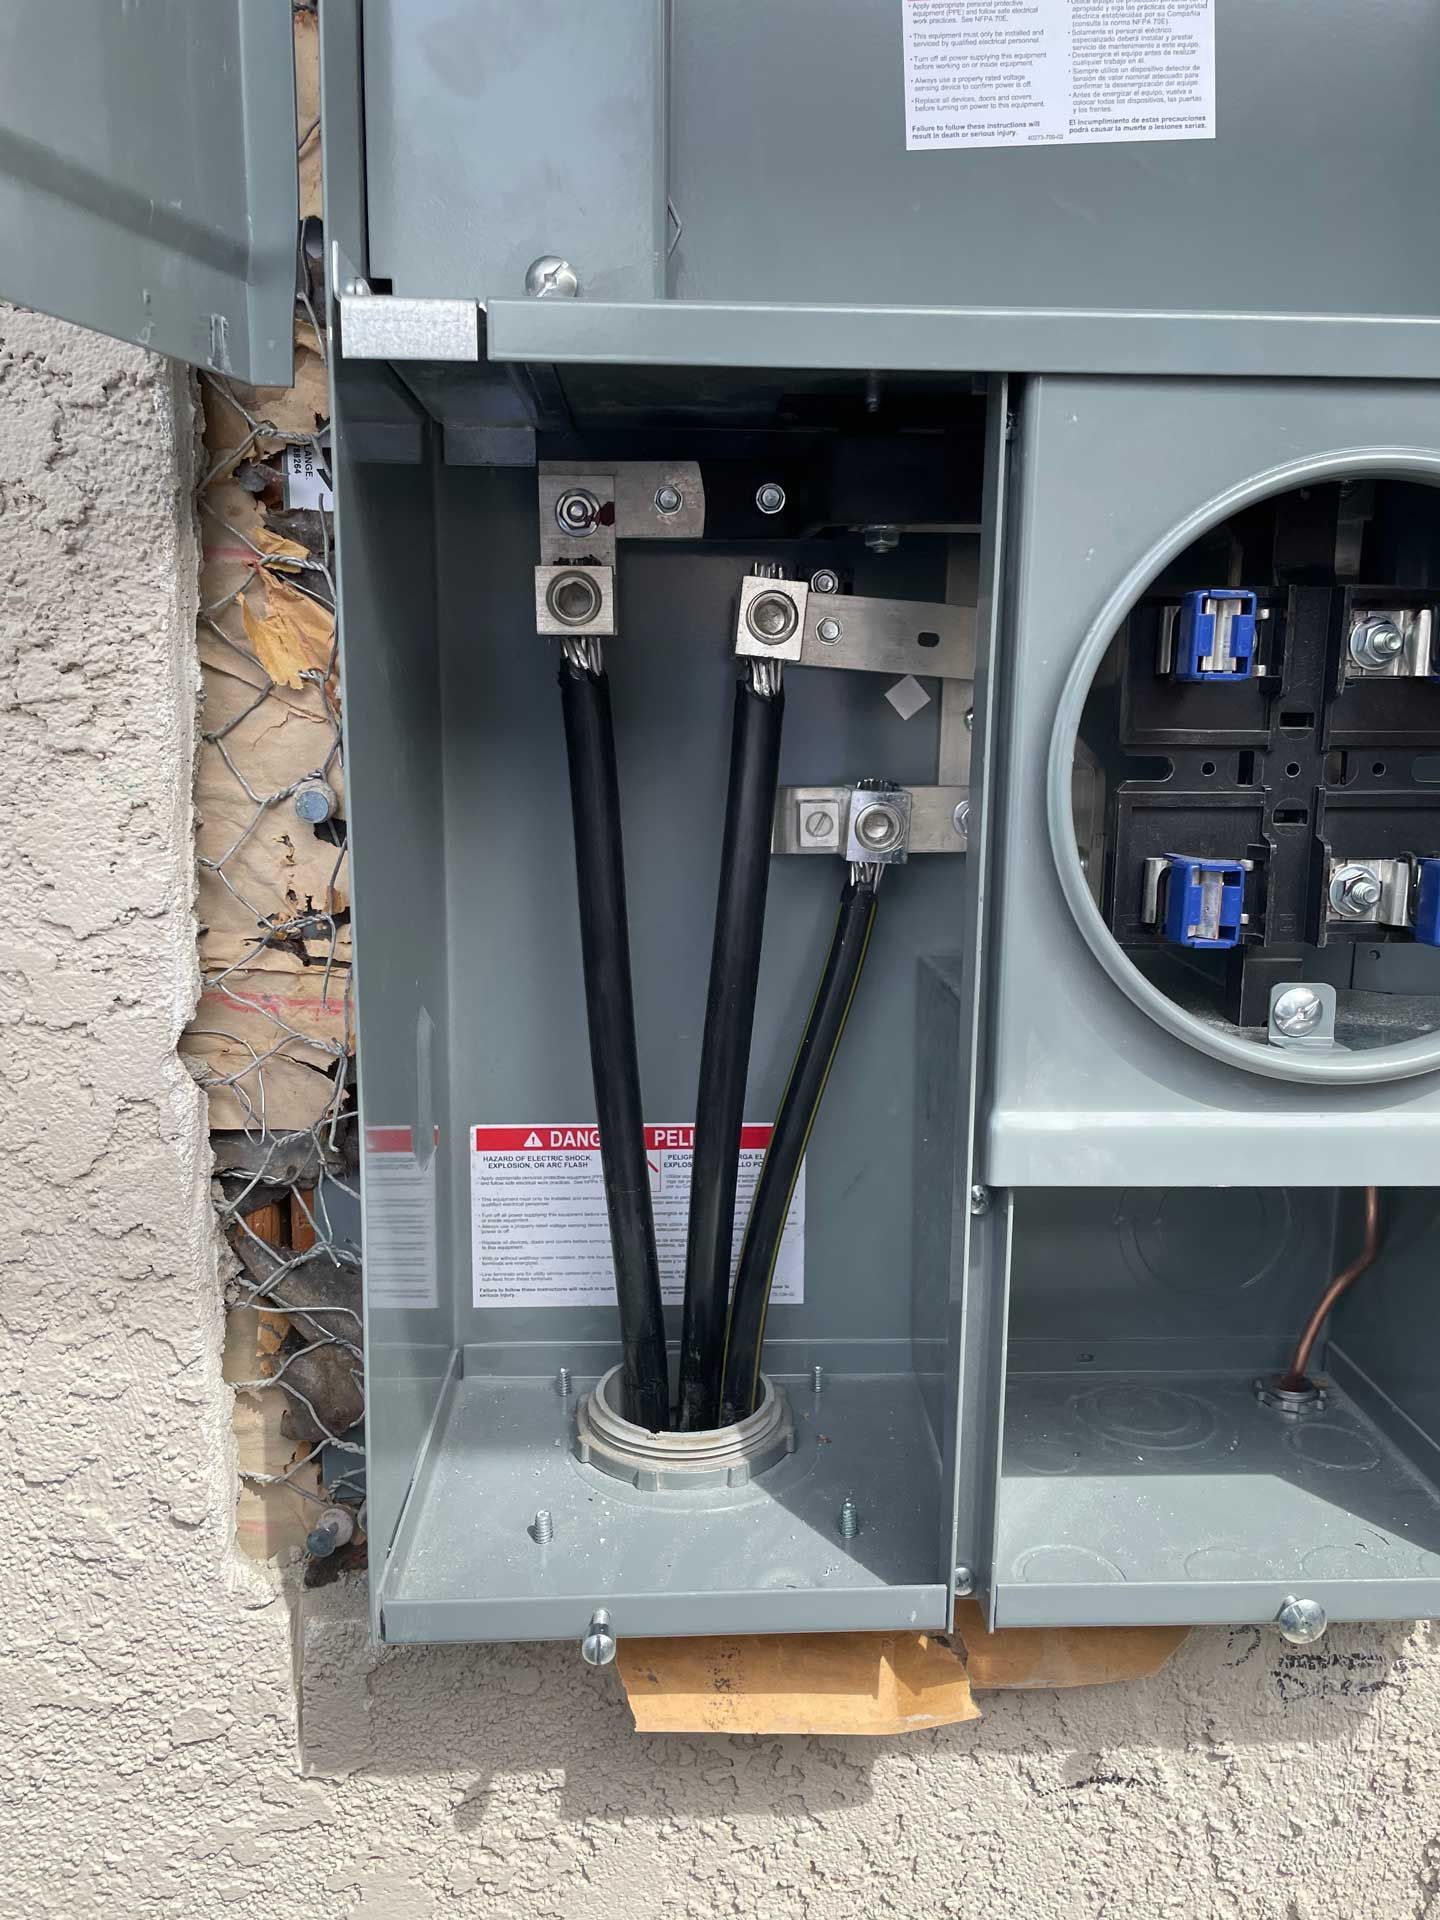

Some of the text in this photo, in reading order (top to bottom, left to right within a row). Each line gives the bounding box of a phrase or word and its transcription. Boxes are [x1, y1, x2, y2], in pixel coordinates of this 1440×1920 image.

[928, 33, 961, 41] equipment
[980, 31, 993, 39] only
[970, 54, 1000, 62] supplying
[1014, 52, 1047, 60] equipment
[915, 77, 937, 85] Always
[957, 76, 983, 84] properly
[1003, 74, 1025, 82] voltage
[914, 85, 939, 93] sensing
[987, 121, 1027, 129] instructions
[1078, 118, 1129, 127] incumplimiento
[1161, 115, 1206, 124] precauciones
[550, 1130, 601, 1147] DANG
[654, 1130, 694, 1147] PELI
